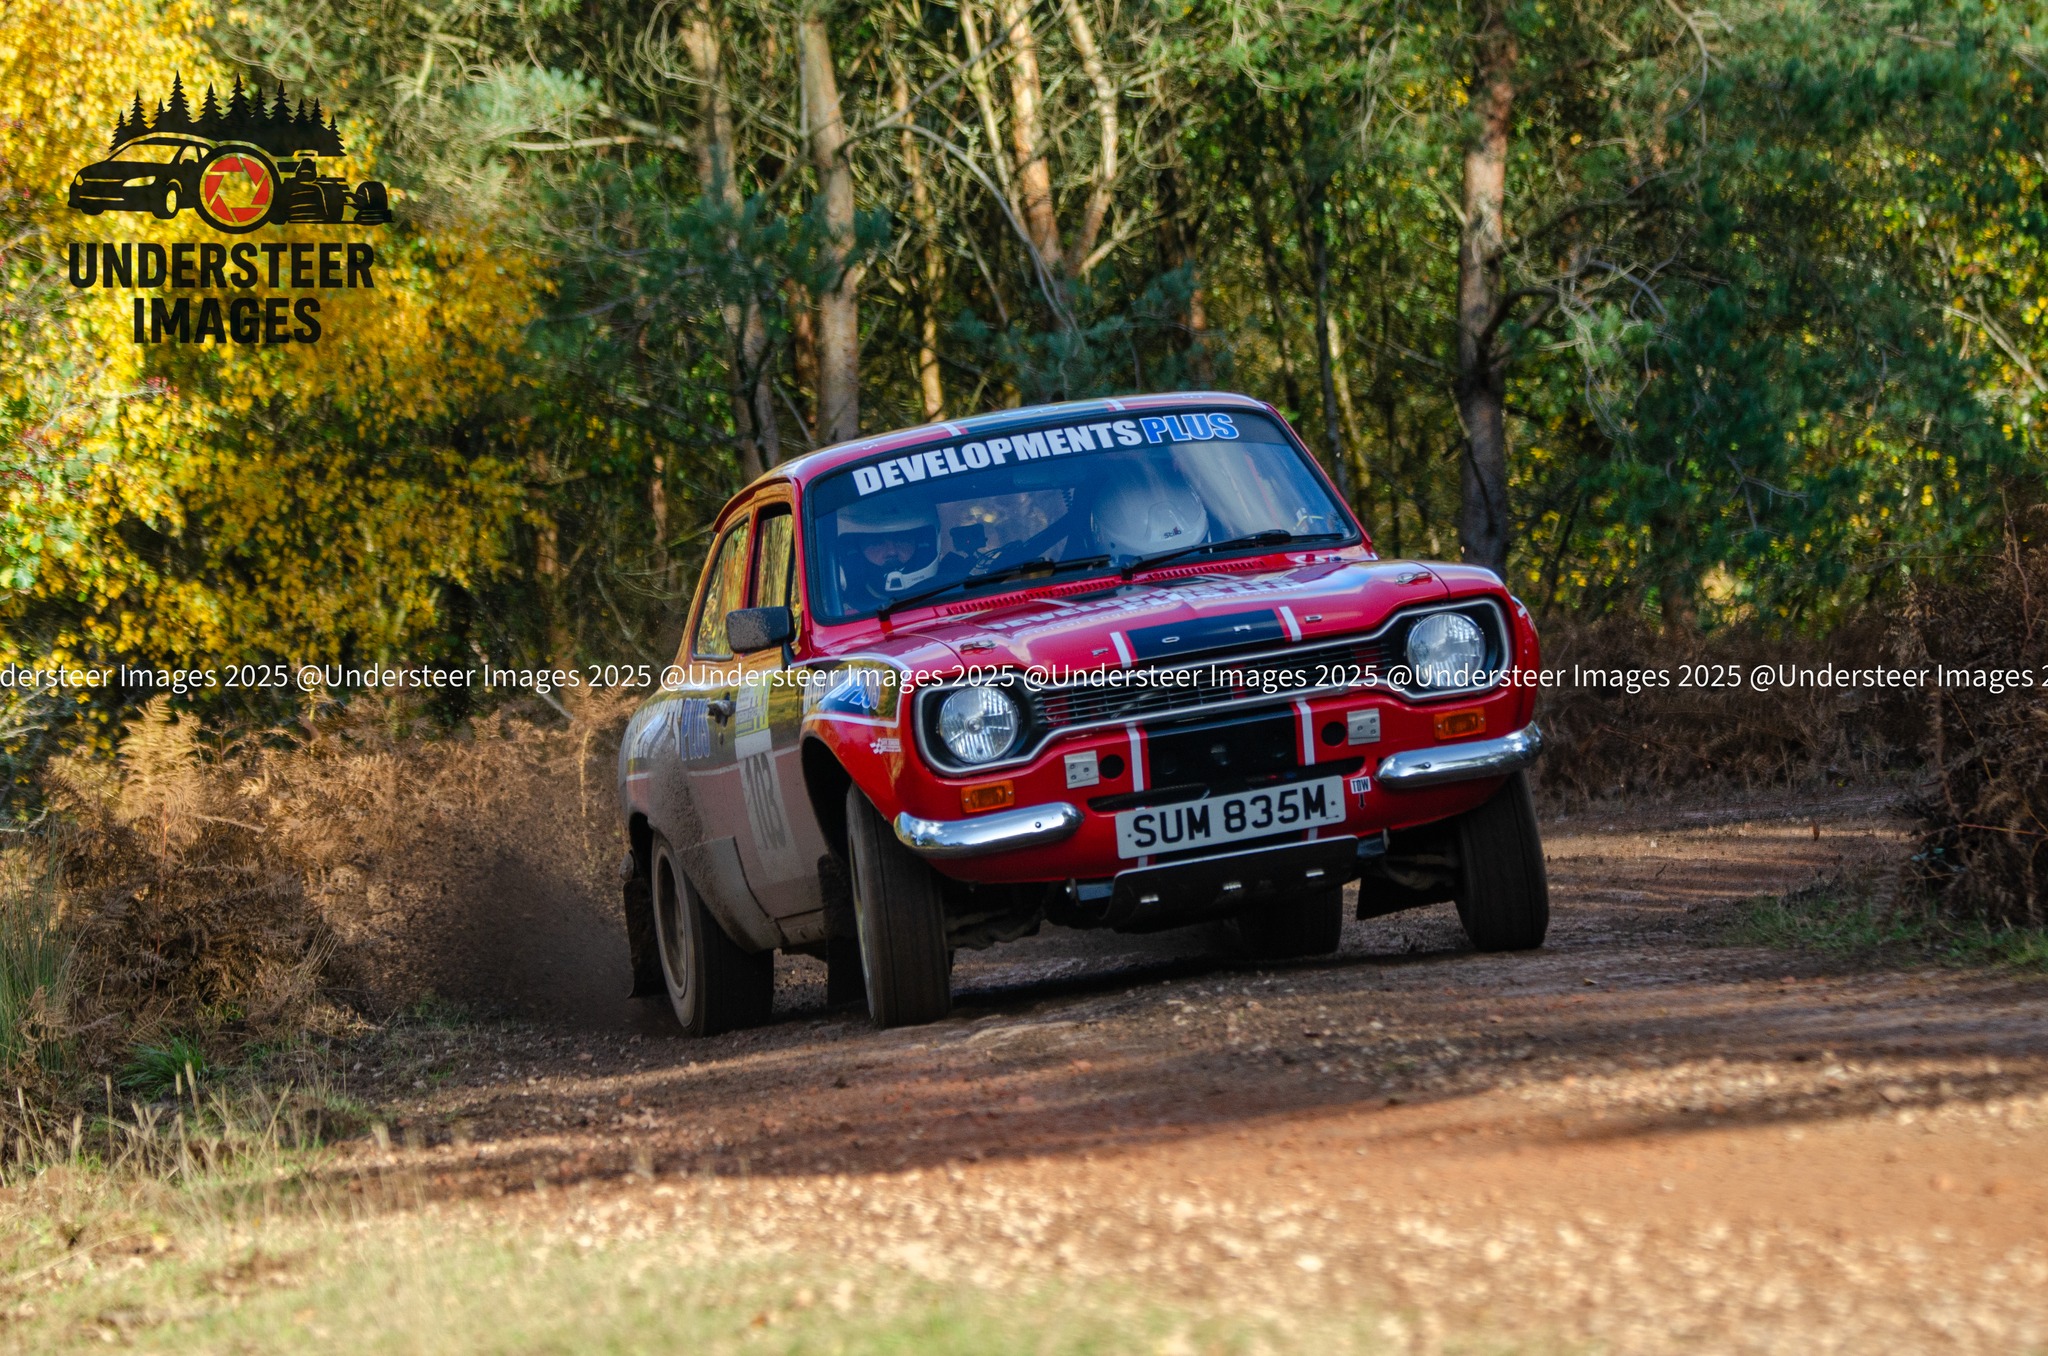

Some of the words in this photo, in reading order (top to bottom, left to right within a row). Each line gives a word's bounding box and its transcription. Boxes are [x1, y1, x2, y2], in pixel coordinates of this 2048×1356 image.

[1352, 778, 1369, 792] TOW
[1132, 804, 1211, 848] SUM
[1223, 784, 1327, 834] 835M
